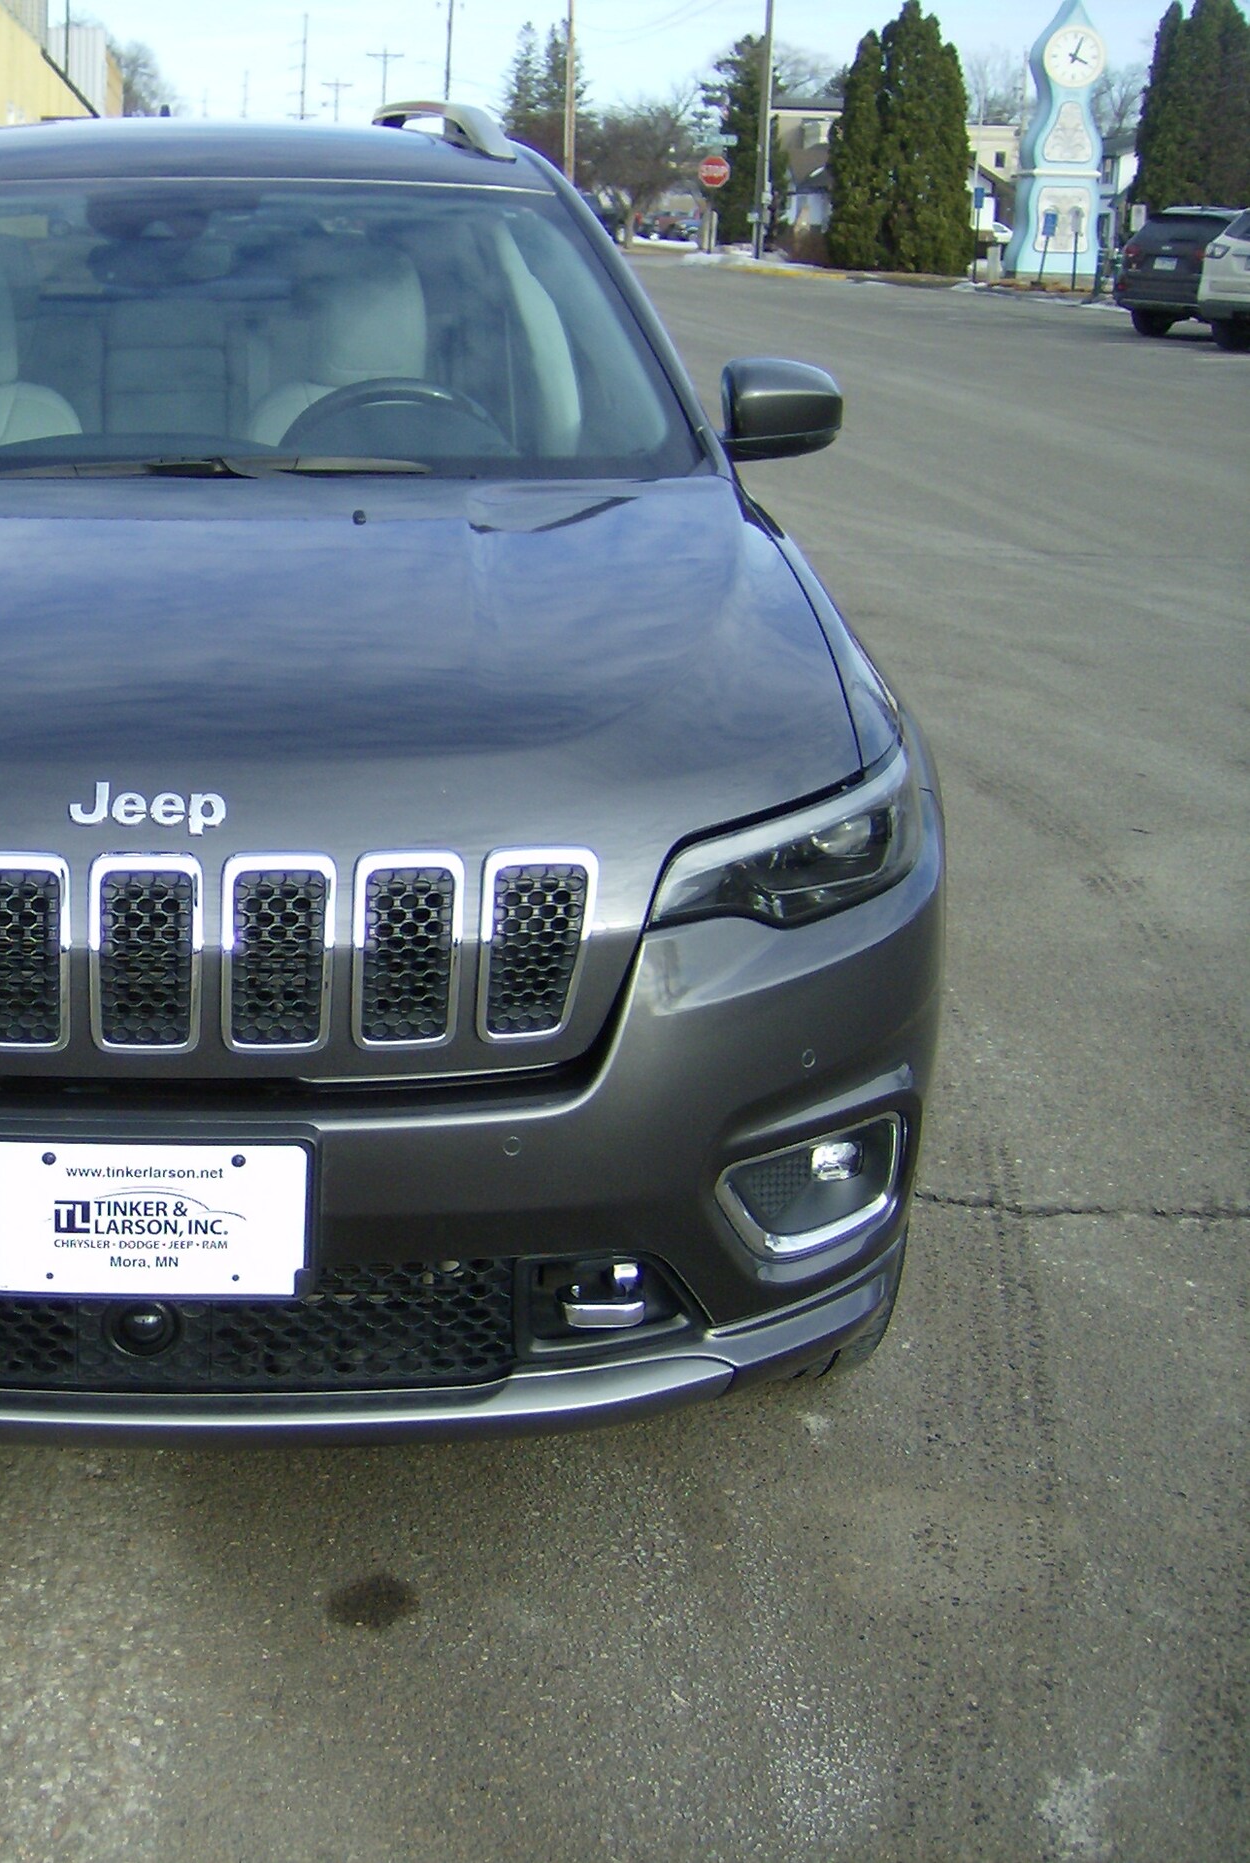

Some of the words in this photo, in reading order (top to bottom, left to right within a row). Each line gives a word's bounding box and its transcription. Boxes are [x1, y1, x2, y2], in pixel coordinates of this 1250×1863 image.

[69, 781, 227, 837] Jeep
[66, 1166, 224, 1179] www.tinkerlarson.net
[94, 1201, 168, 1217] TINKER
[172, 1201, 188, 1217] &
[94, 1219, 184, 1237] LARSON,
[187, 1219, 228, 1235] INC.
[54, 1239, 110, 1249] CHRYSLER
[118, 1240, 160, 1250] DODGE
[168, 1240, 194, 1250] JEEP
[202, 1240, 228, 1250] RAM
[110, 1256, 151, 1269] Mora,
[155, 1256, 179, 1268] MN
